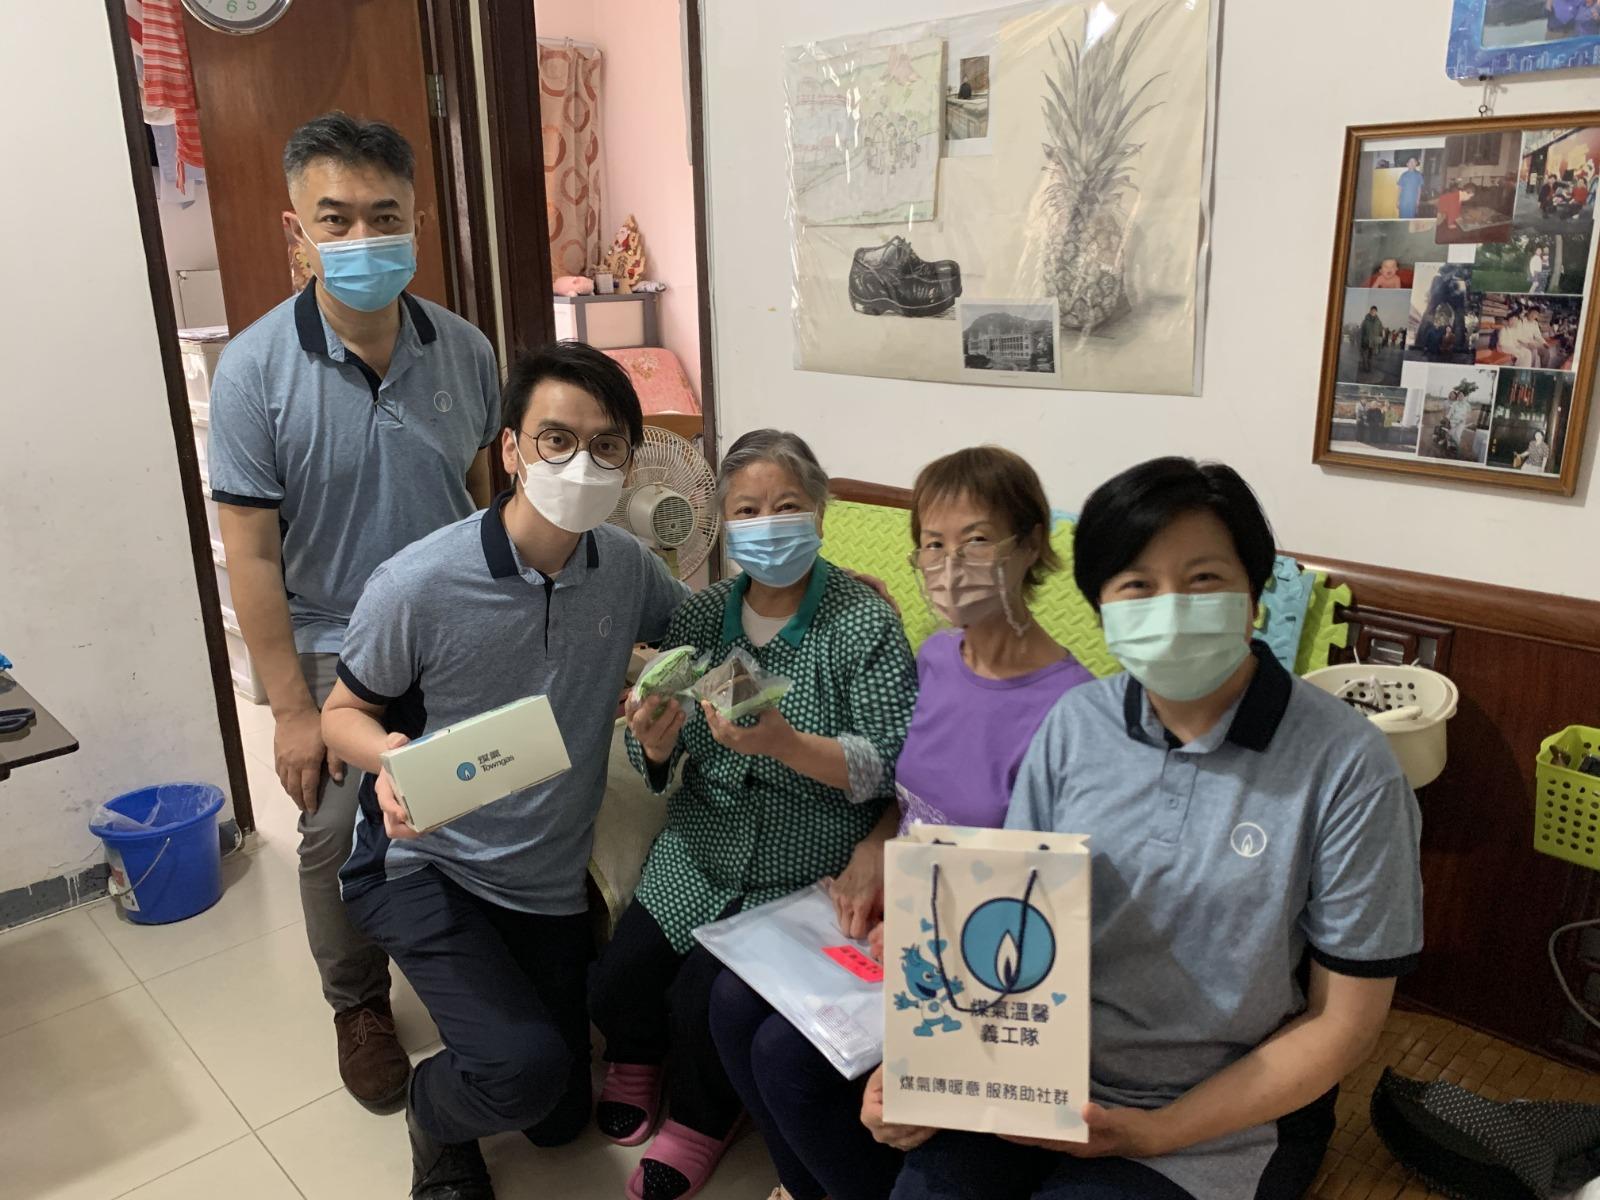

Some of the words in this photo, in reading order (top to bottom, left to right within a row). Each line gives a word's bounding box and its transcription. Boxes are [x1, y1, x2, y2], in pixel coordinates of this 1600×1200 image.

[226, 0, 238, 13] 6
[246, 0, 256, 11] 5
[481, 755, 515, 771] Towngas
[981, 1024, 1039, 1046] 義工隊
[900, 1075, 980, 1097] 煤氣傳暖意
[986, 1082, 1068, 1105] 服務助社群
